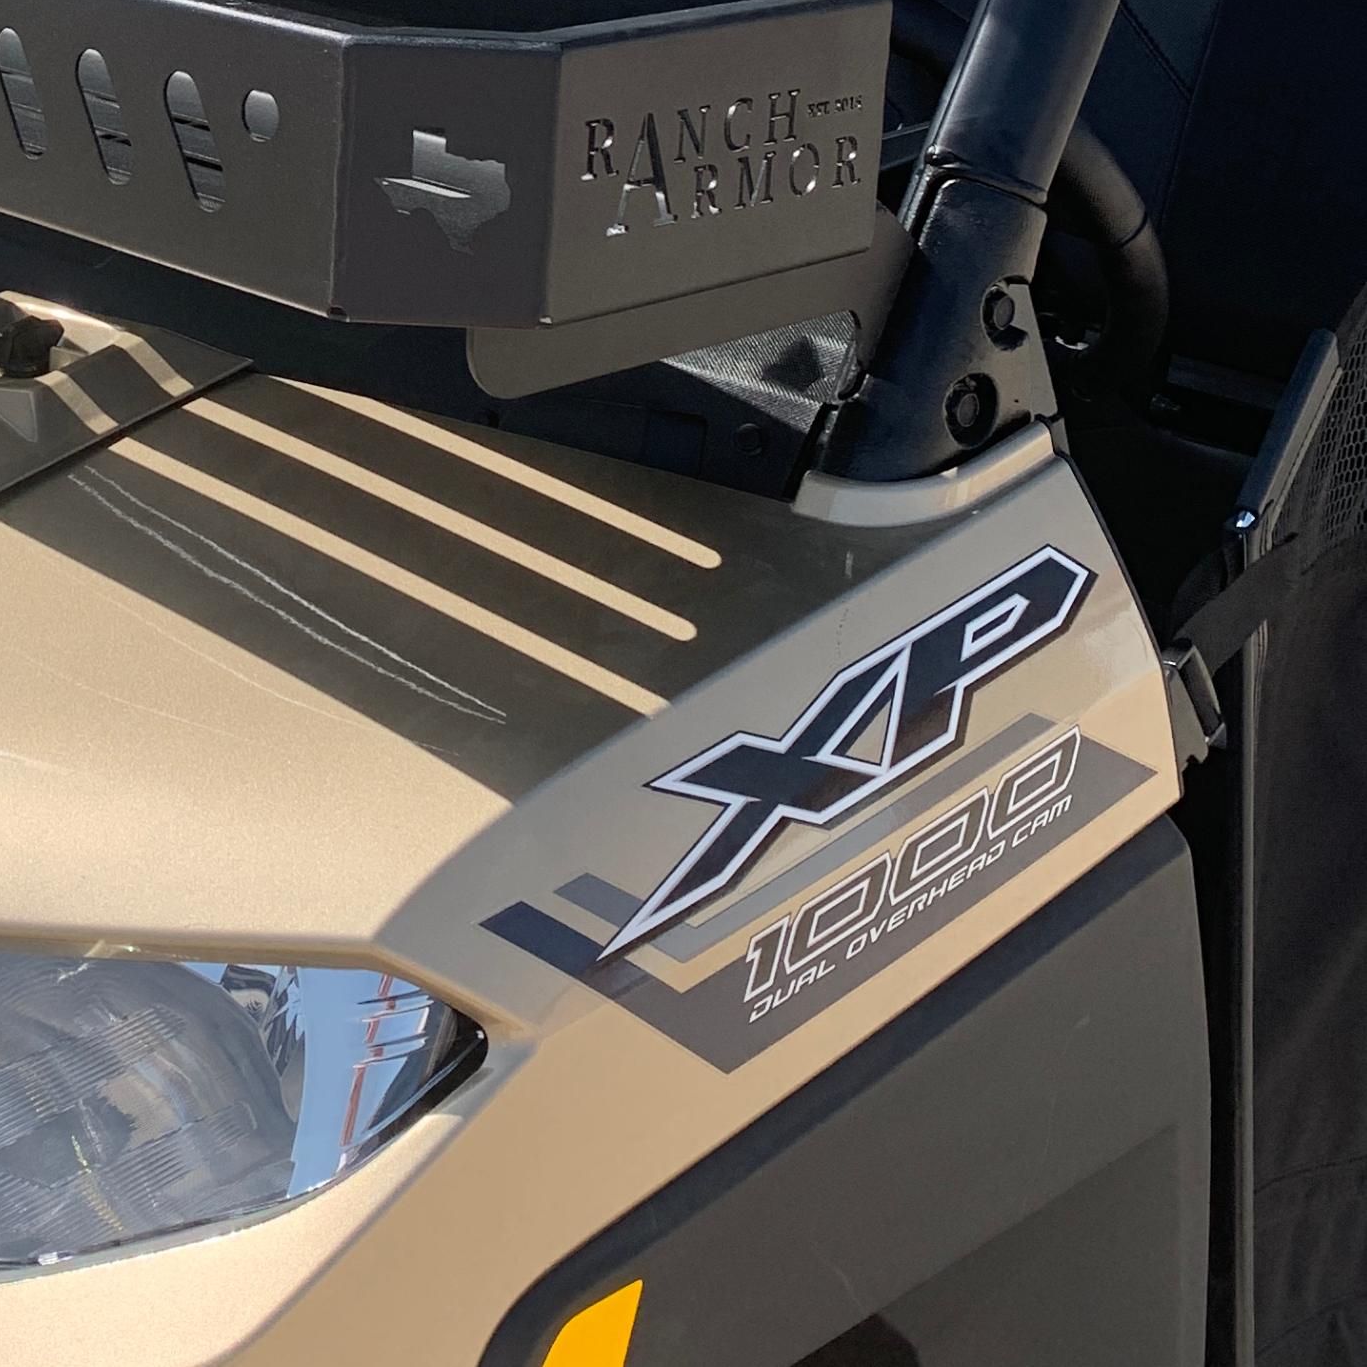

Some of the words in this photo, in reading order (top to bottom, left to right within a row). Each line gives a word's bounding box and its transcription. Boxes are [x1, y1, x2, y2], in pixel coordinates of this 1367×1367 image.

[580, 88, 801, 184] RANCH
[605, 112, 862, 237] ARMOR
[596, 543, 1098, 963] XP
[743, 723, 1081, 1003] 1000
[748, 959, 835, 1024] DUAL
[845, 839, 1006, 961] OVERHEAD
[1012, 794, 1073, 848] CAM
